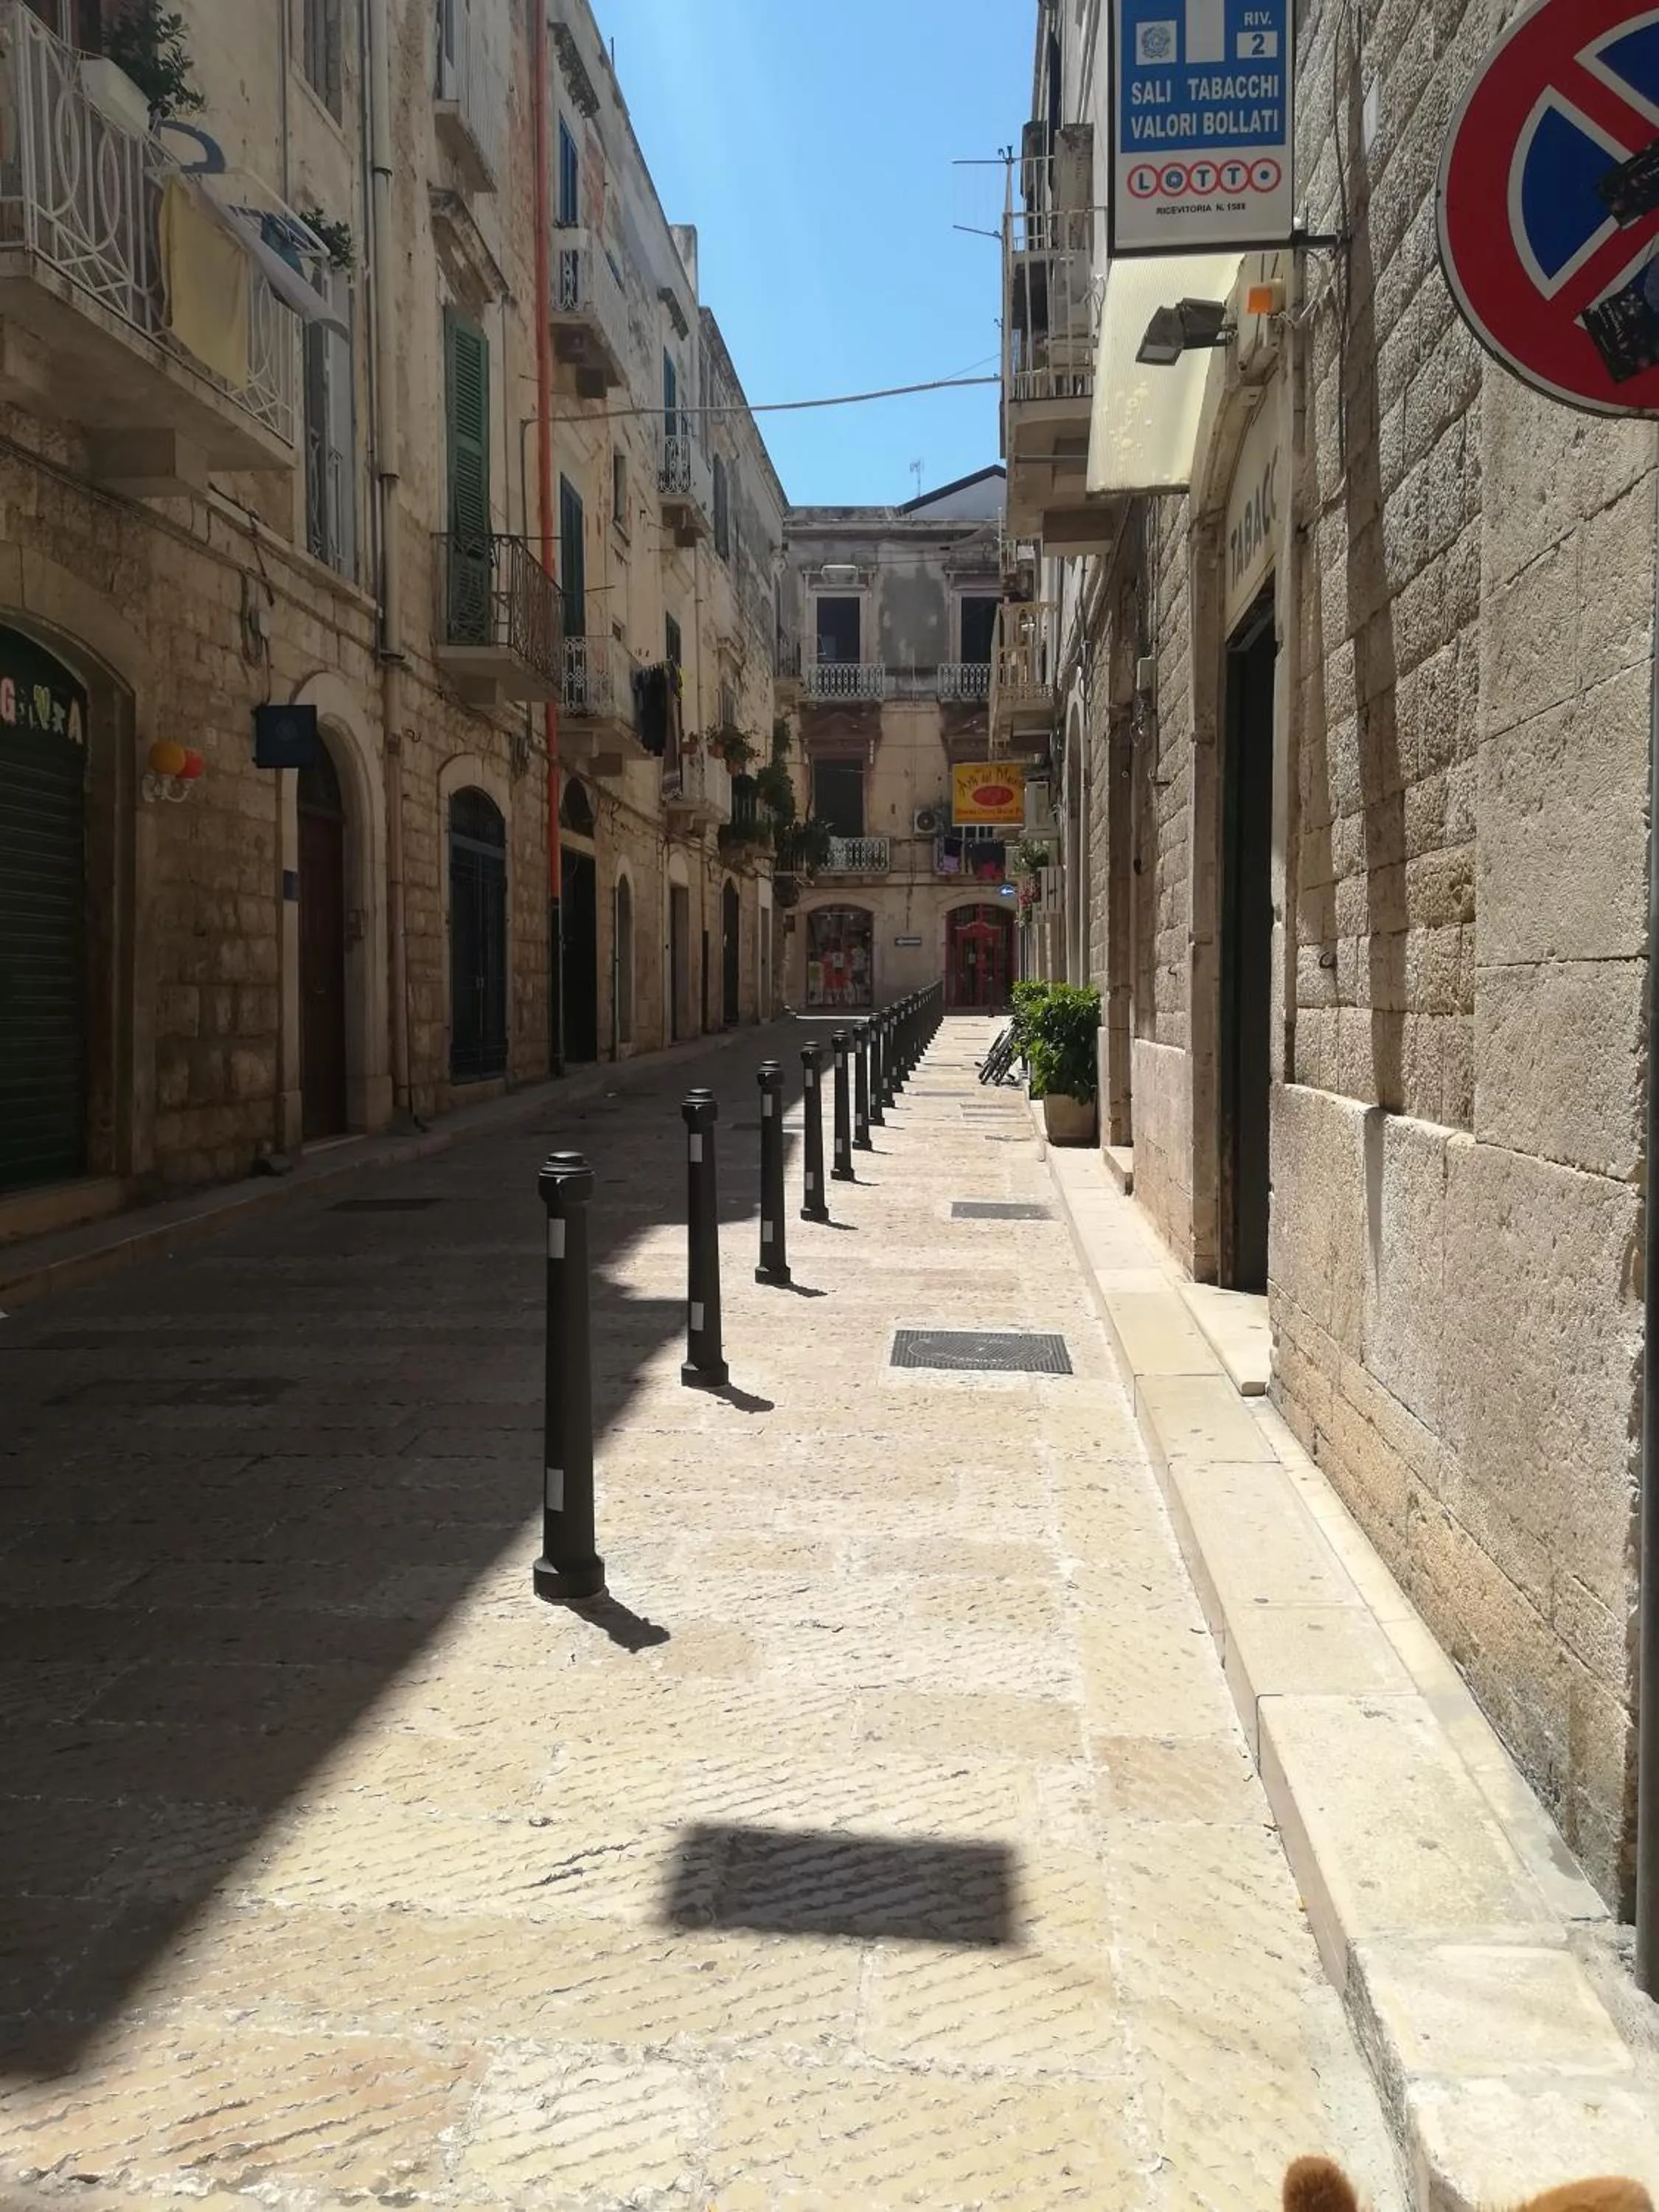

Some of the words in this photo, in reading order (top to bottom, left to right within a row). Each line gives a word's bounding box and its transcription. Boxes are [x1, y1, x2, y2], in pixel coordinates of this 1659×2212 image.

[1244, 11, 1272, 26] RIV.
[1251, 33, 1265, 55] 2
[1132, 80, 1171, 105] SALI
[1188, 74, 1279, 101] TABACCHI
[1131, 113, 1197, 139] VALORI
[1203, 109, 1278, 135] BOLLATI
[1156, 204, 1211, 215] RICEVITORIA
